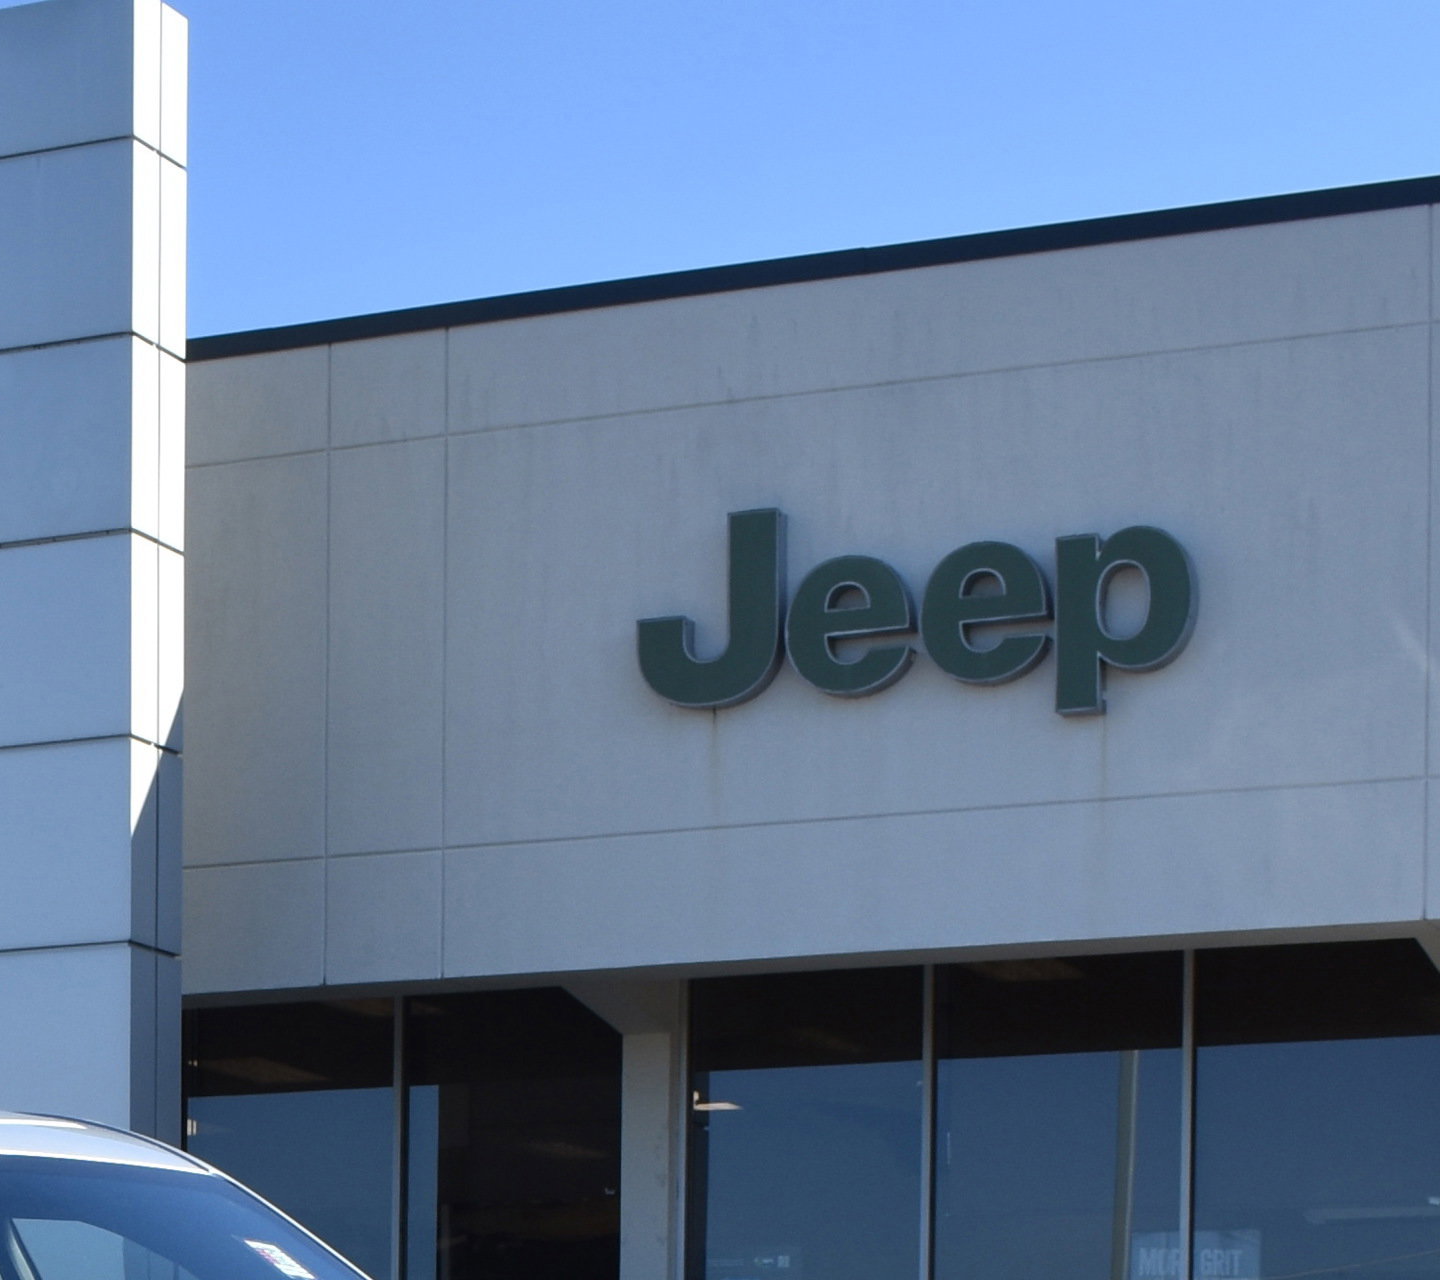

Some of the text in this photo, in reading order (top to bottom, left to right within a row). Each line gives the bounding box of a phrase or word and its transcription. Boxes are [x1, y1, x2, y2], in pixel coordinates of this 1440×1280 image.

[636, 507, 1199, 717] Jeep
[1138, 1248, 1243, 1276] MOR GRIT
